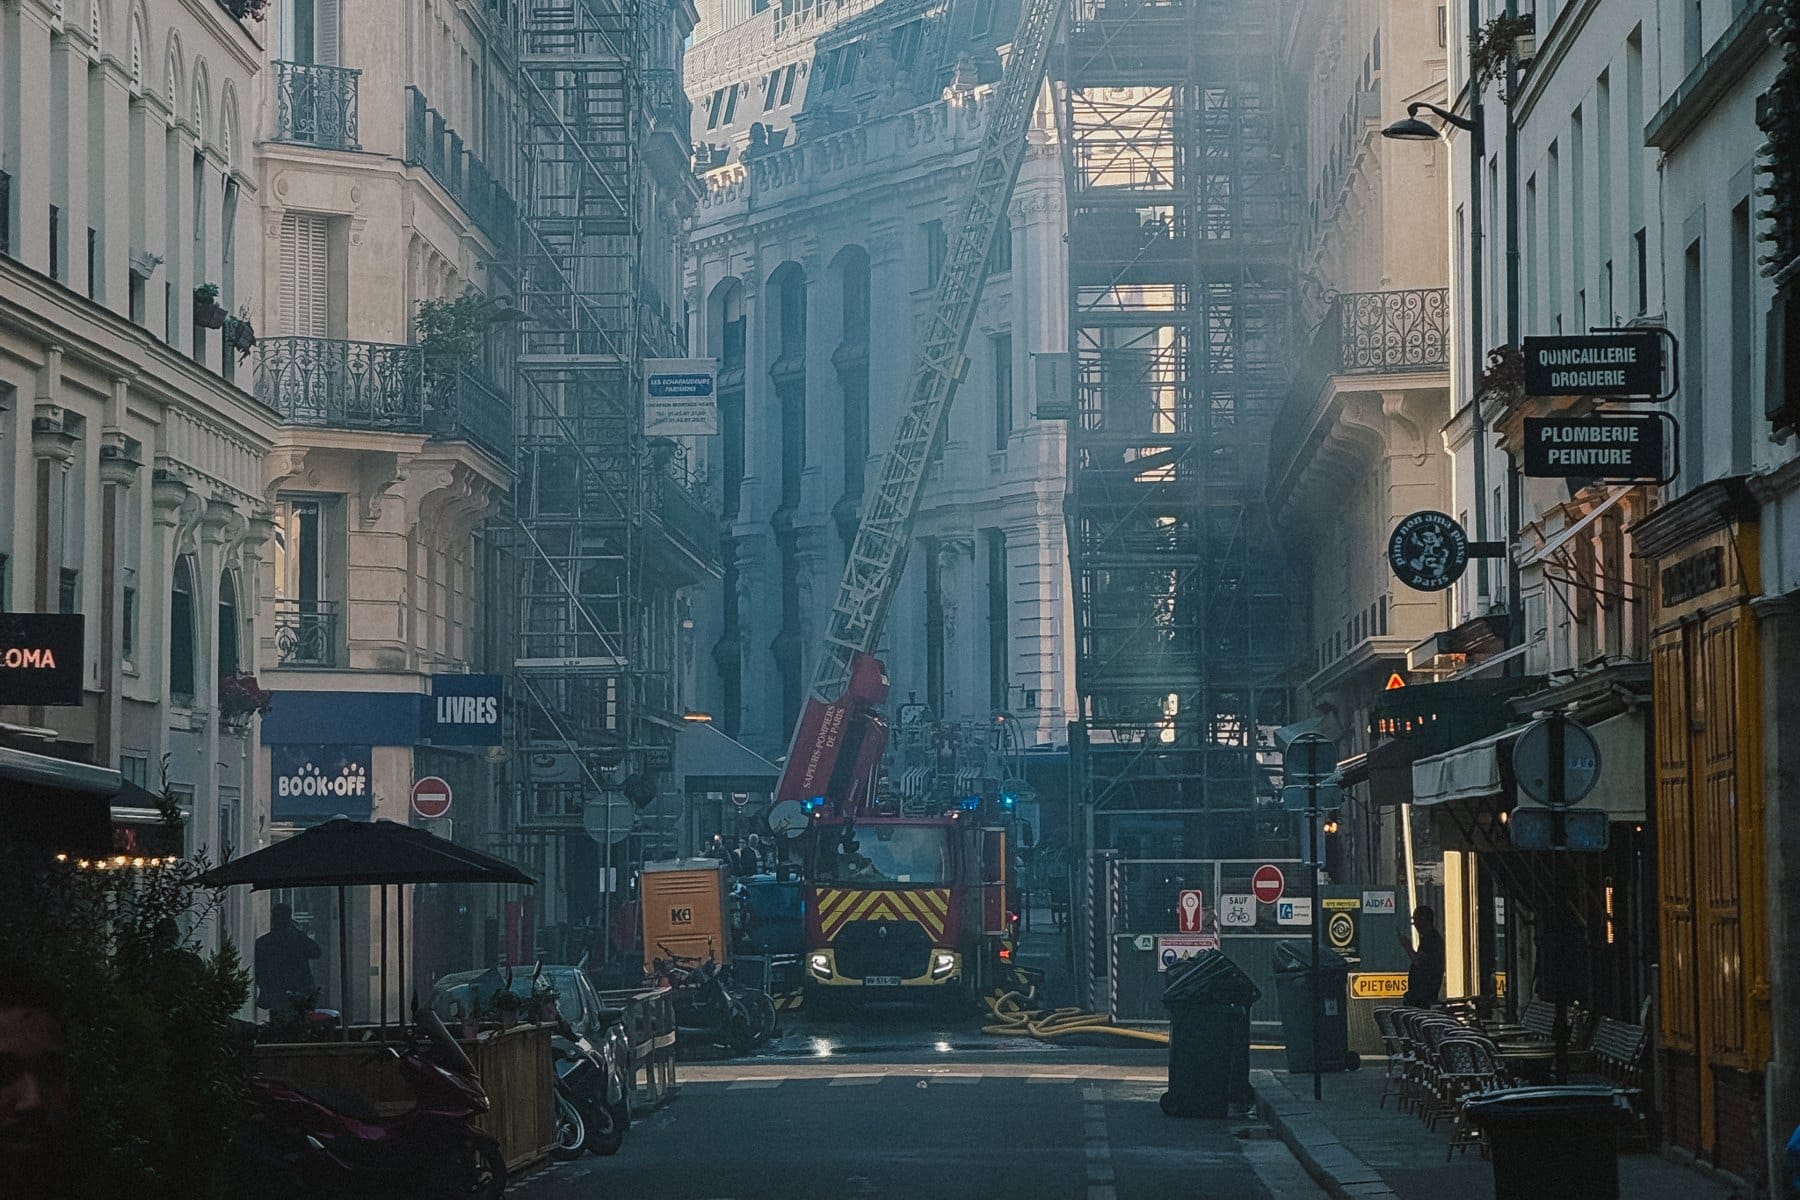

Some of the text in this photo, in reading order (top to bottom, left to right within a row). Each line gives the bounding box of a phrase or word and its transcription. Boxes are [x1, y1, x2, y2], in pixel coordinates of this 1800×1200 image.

[1539, 348, 1637, 366] QUINCAILLERIE
[1551, 370, 1626, 387] DROGUERIE
[1541, 426, 1639, 442] PLOMBERIE
[1548, 449, 1632, 464] PEINTURE
[1394, 536, 1406, 566] pino
[1400, 516, 1424, 535] non
[1425, 514, 1452, 529] ama
[437, 696, 498, 724] LIVRES
[826, 708, 845, 748] DE PARIS
[1229, 896, 1248, 905] SAUF
